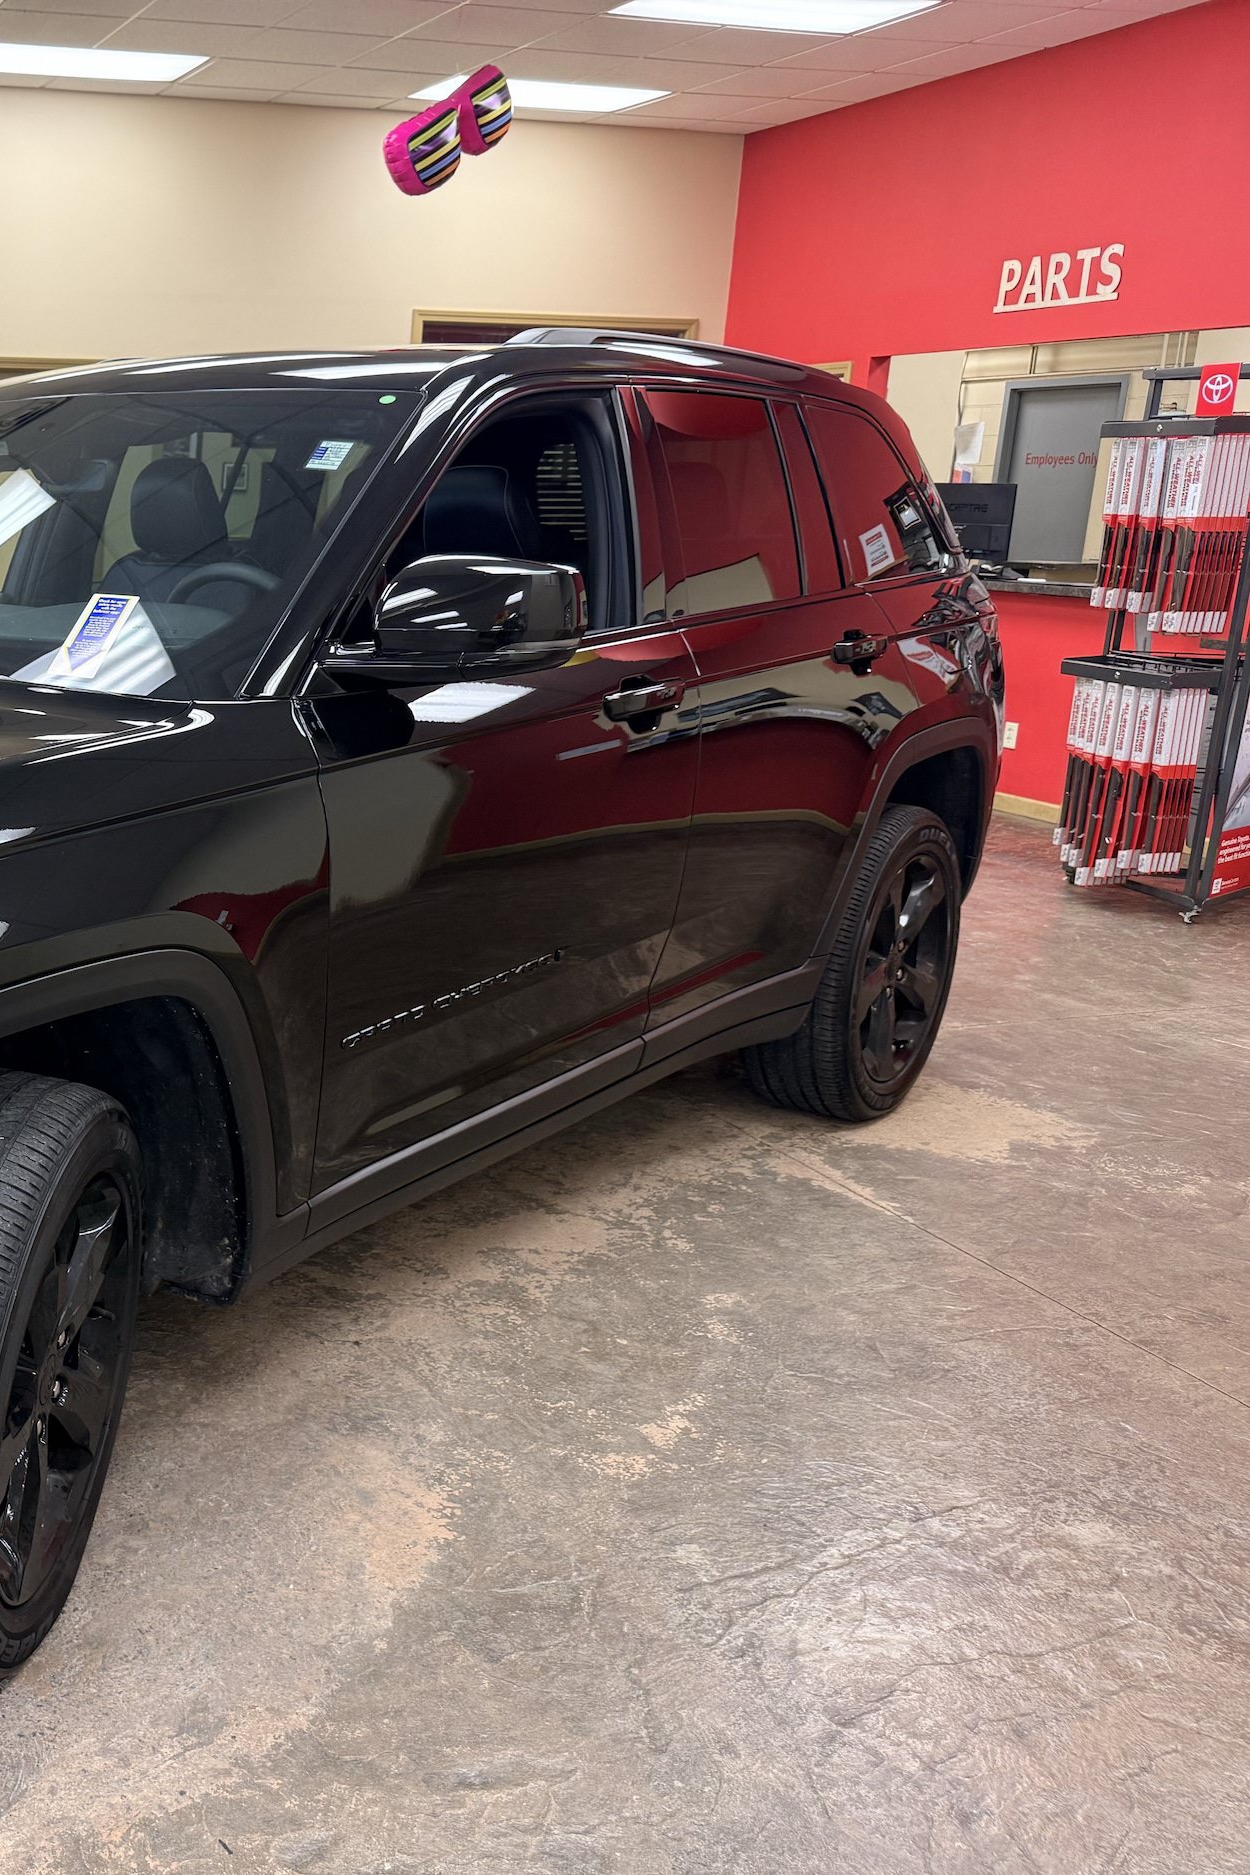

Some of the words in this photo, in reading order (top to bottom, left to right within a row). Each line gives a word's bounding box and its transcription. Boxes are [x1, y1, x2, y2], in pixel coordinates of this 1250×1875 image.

[995, 243, 1125, 308] PARTS
[1025, 452, 1075, 468] Employees
[1077, 451, 1098, 469] Only
